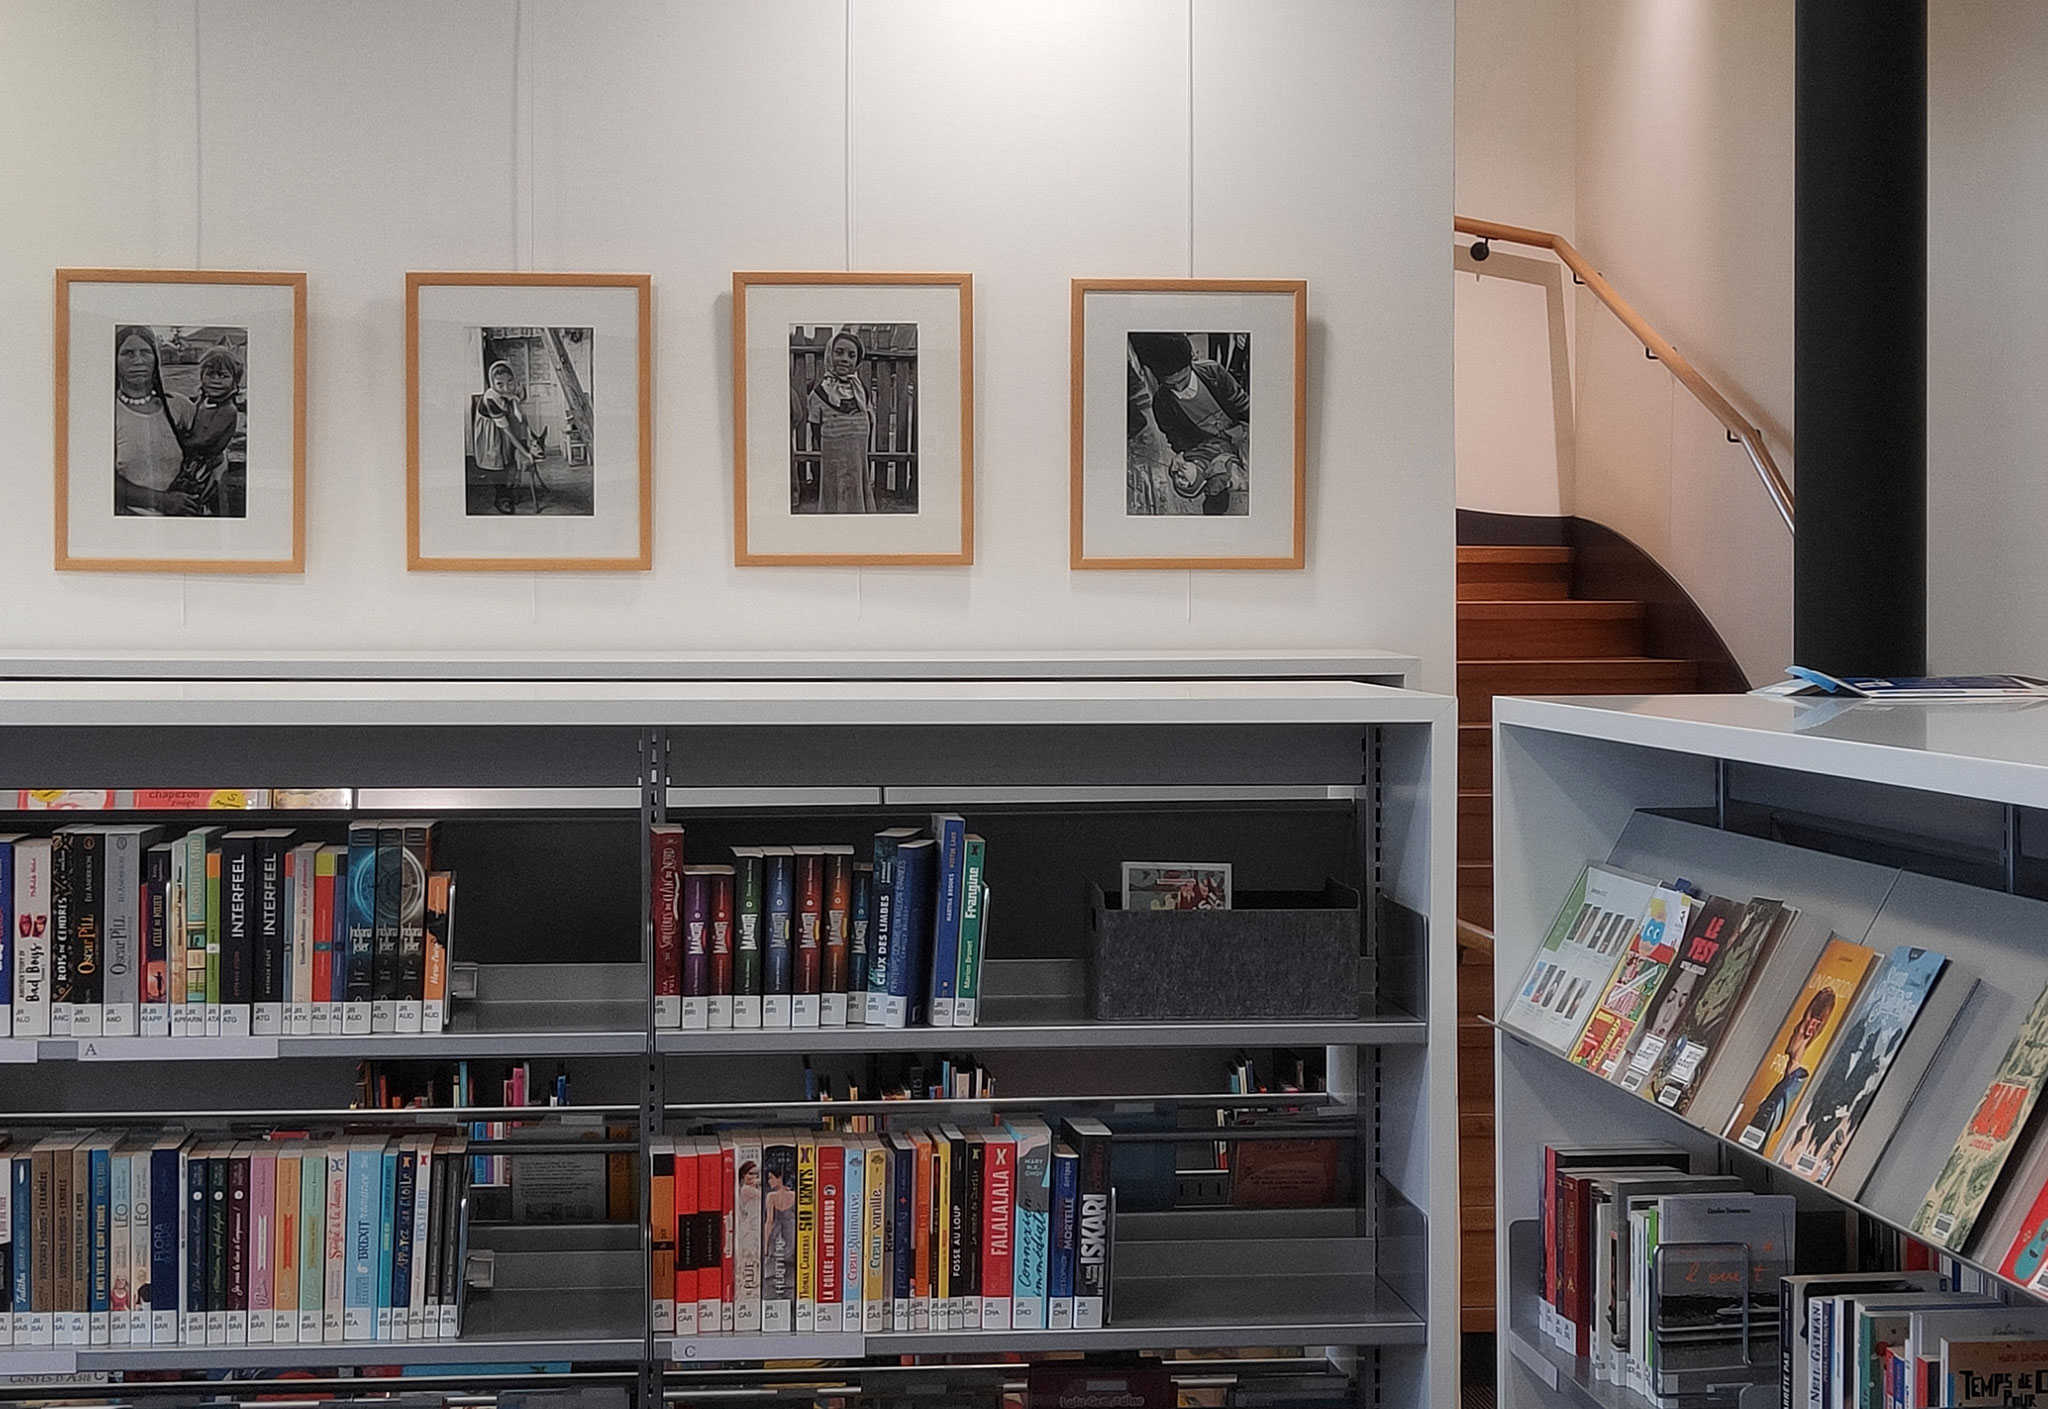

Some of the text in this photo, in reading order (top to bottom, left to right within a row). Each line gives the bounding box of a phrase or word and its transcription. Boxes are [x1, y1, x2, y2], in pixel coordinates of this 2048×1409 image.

[232, 855, 245, 937] INTERFEEL
[264, 853, 276, 935] INTERFEEL
[965, 867, 980, 919] Frangine
[57, 897, 67, 941] CENDRES
[876, 895, 889, 985] CEUX DES LIMBES
[26, 943, 45, 1001] Bad Boys
[84, 1043, 97, 1056] A
[799, 1168, 813, 1205] CENTS
[871, 1189, 881, 1229] vanille
[358, 1173, 370, 1260] BREXIT romance
[799, 1211, 813, 1231] 50
[822, 1200, 835, 1243] HÉRISSONS
[848, 1194, 860, 1249] guimauve
[991, 1170, 1009, 1255] FALALALALA
[1063, 1198, 1073, 1249] MORTELLE
[1081, 1194, 1106, 1263] ISKARI
[154, 1224, 164, 1261] FLORA
[822, 1261, 834, 1287] COLÈRE
[684, 1346, 696, 1358] C
[1782, 1352, 1791, 1373] PAS
[1810, 1306, 1822, 1403] NEIL GAIMAN
[1959, 1370, 2012, 1400] TEMPS
